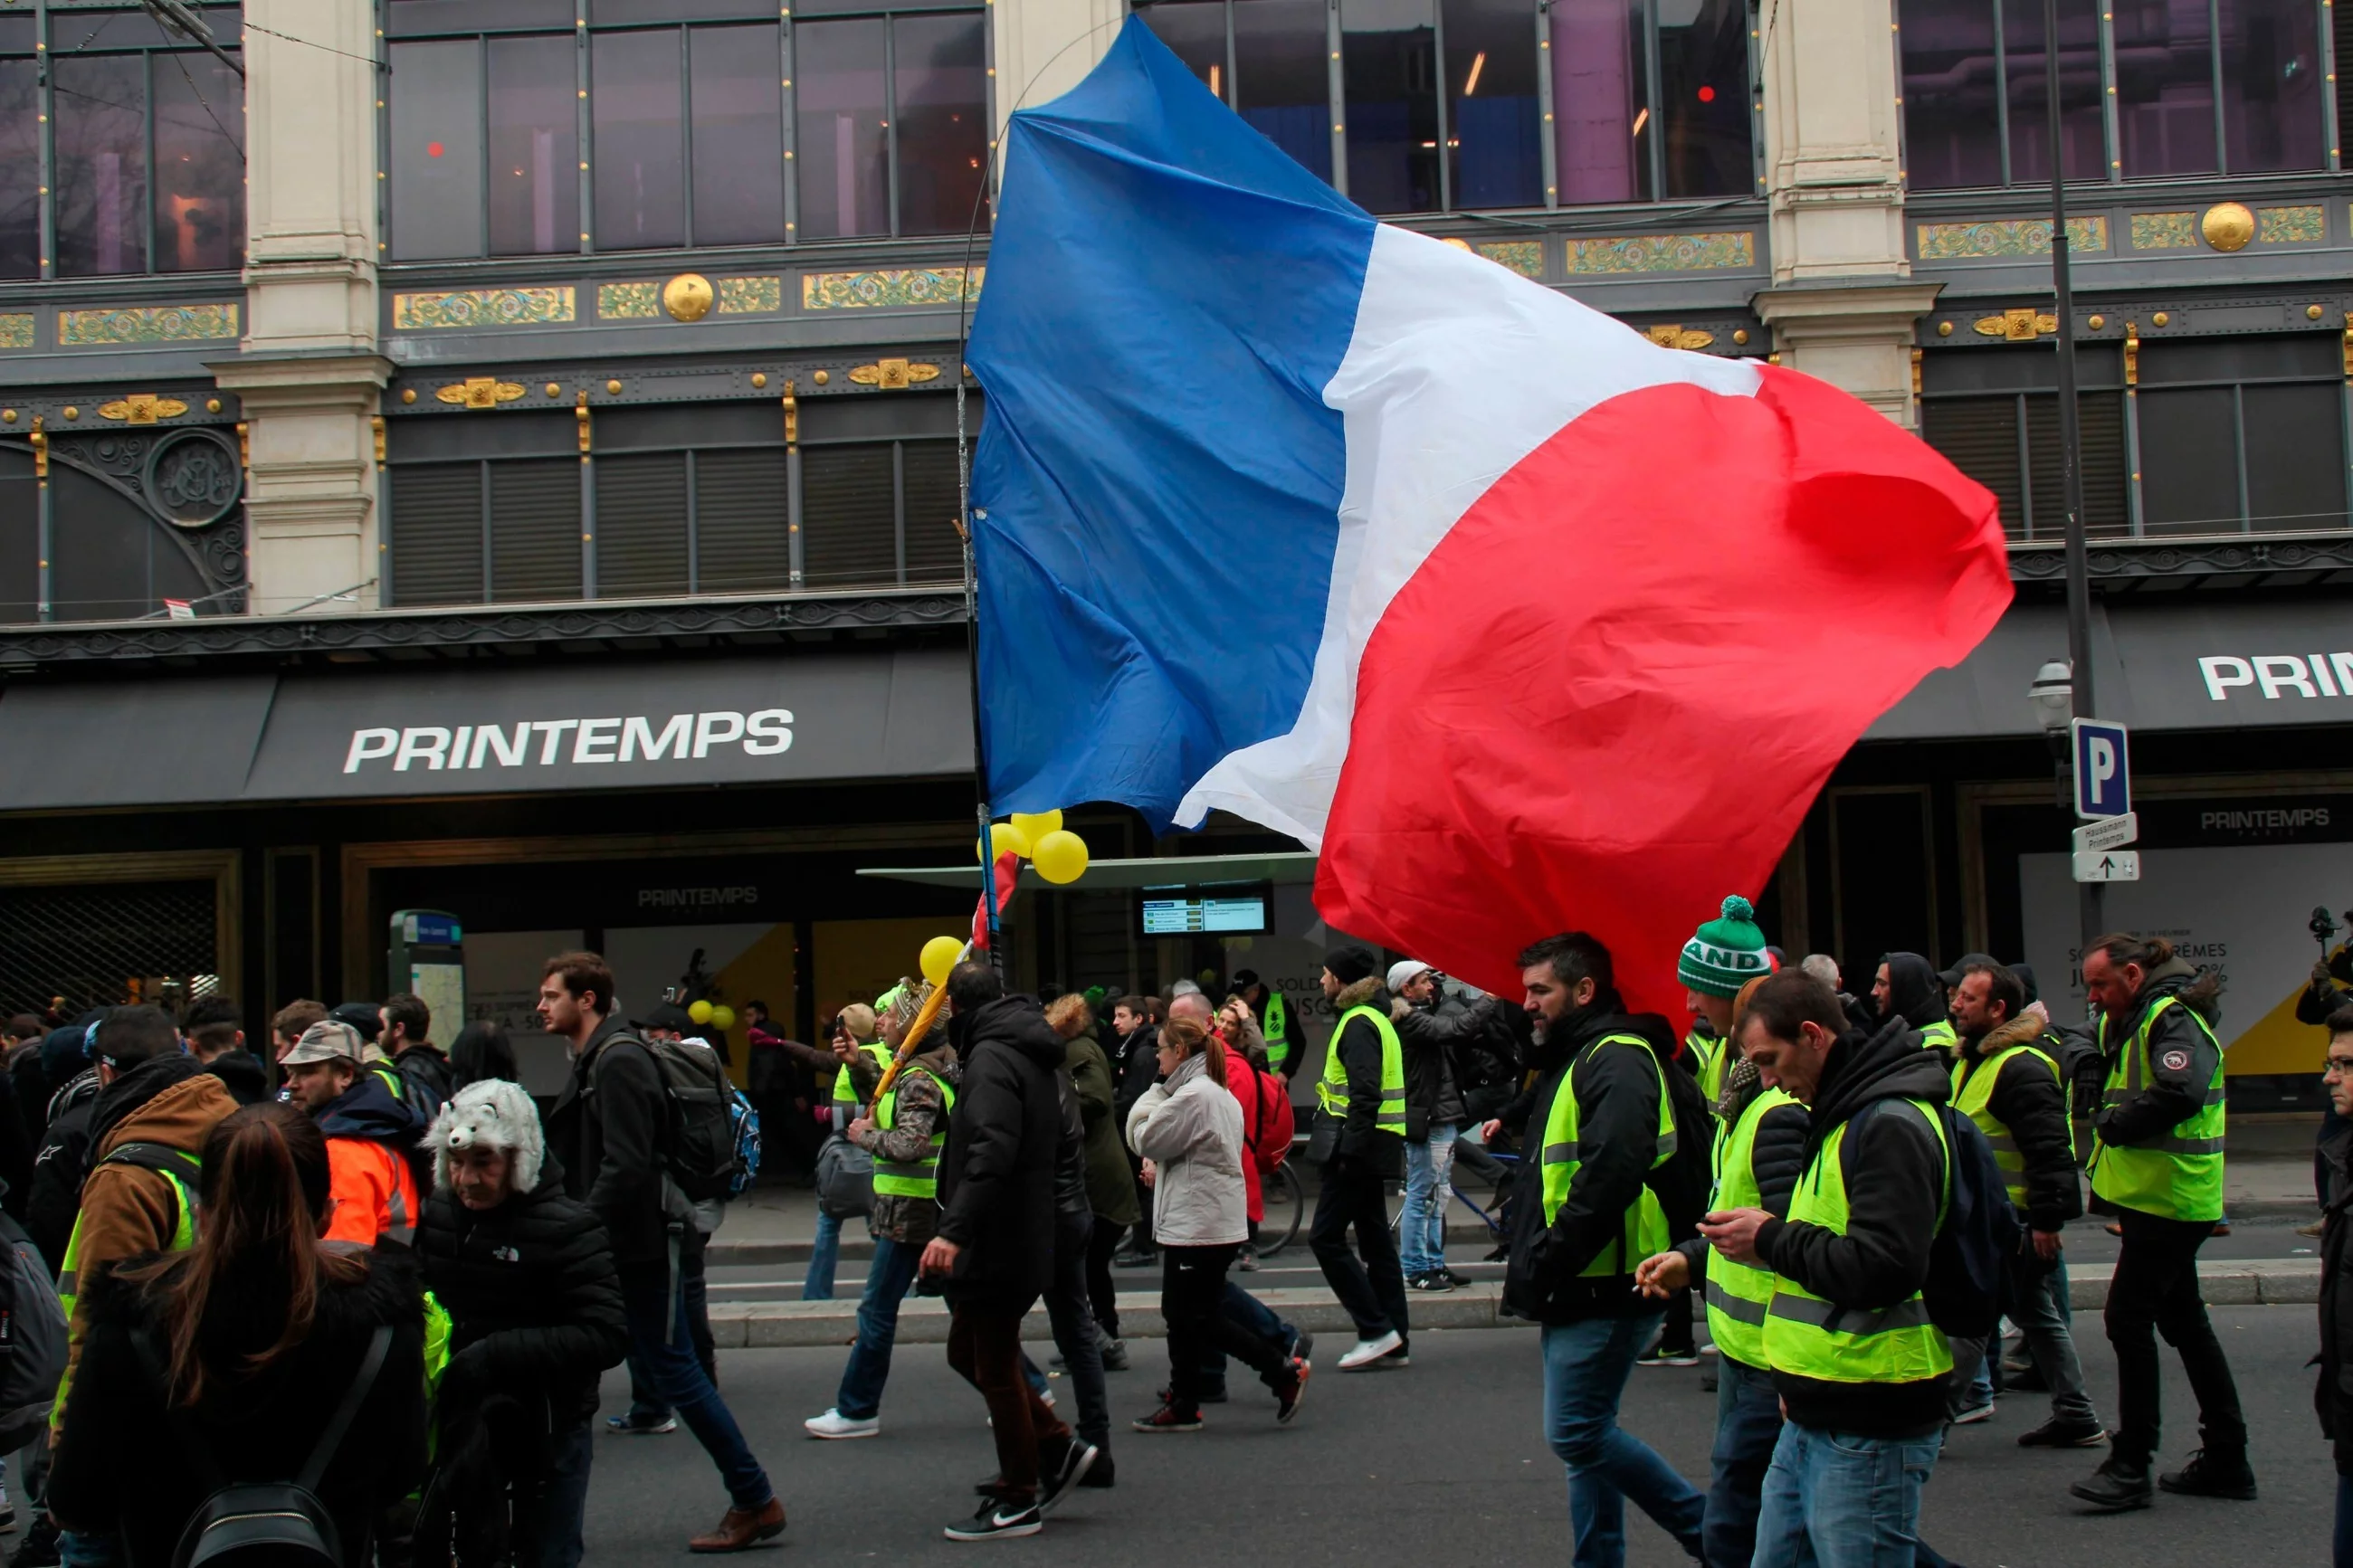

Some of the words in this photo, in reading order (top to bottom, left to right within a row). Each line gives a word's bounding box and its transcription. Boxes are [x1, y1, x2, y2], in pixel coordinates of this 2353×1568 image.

[344, 708, 795, 774] PRINTEMPS
[2089, 736, 2116, 804] P
[2085, 820, 2127, 838] Haussmann
[2201, 807, 2330, 829] PRINTEMPS
[2088, 832, 2124, 851] Printemps
[637, 886, 758, 908] PRINTEMPS
